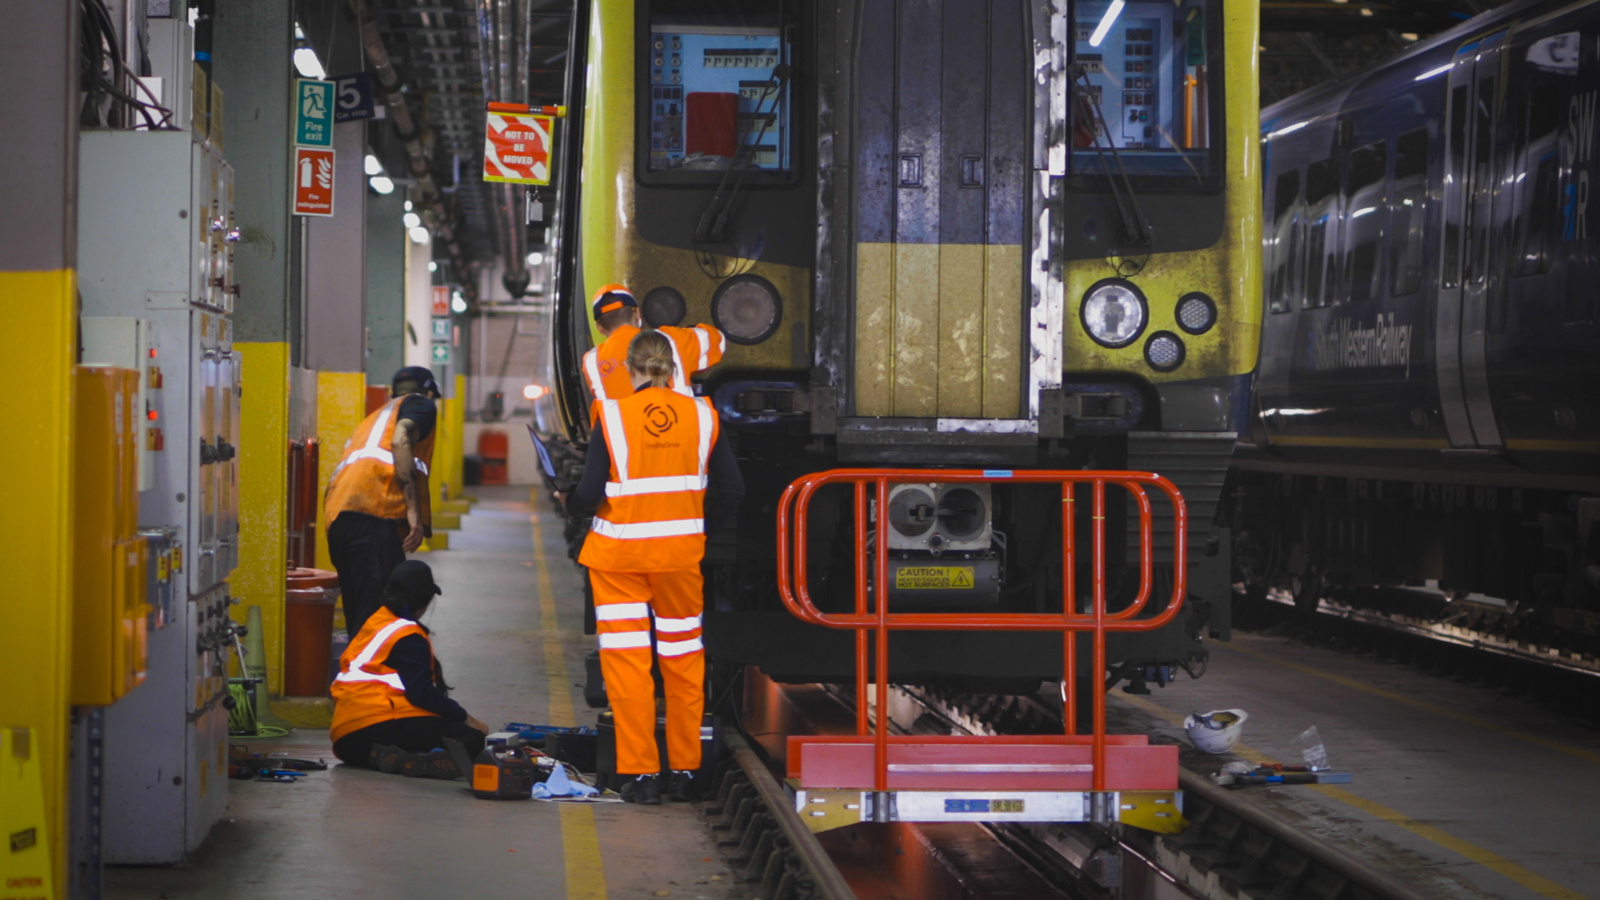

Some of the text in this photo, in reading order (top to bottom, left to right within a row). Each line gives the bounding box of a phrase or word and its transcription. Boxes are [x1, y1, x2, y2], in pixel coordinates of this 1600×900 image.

[338, 78, 361, 109] 5
[352, 109, 368, 117] stop
[305, 121, 323, 132] Fire
[1566, 90, 1598, 166] SW
[305, 132, 322, 141] exit
[505, 131, 535, 140] NOT TO
[513, 144, 525, 152] BE
[503, 155, 533, 165] MOVED
[1575, 170, 1589, 240] R
[898, 568, 944, 577] CAUTION
